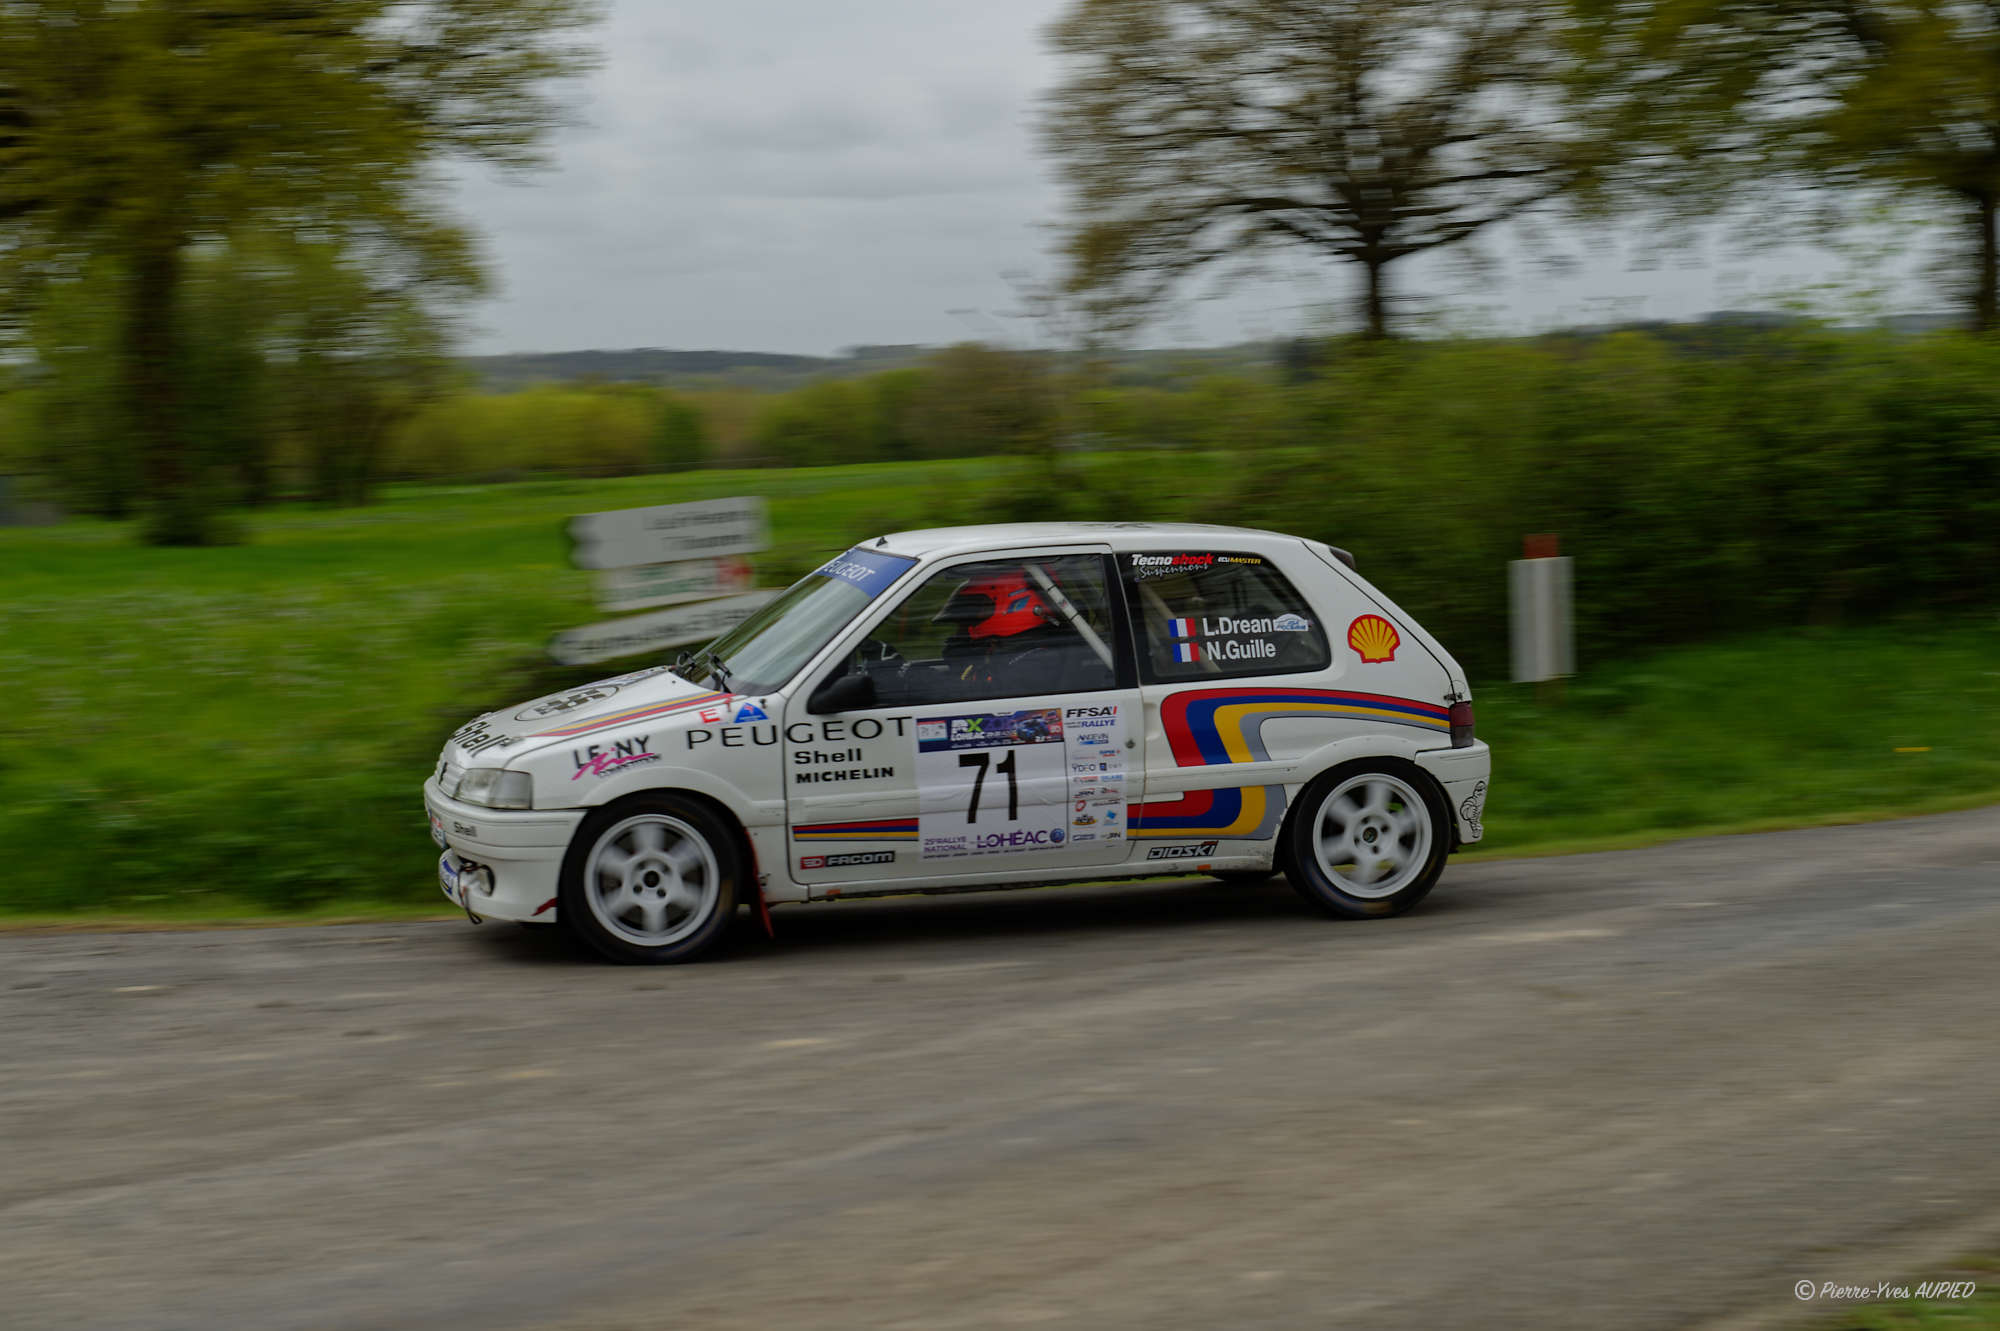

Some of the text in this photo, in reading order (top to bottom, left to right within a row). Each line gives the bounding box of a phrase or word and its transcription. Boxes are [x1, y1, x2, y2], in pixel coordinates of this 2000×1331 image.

[1202, 617, 1272, 636] L.Drean
[1206, 639, 1276, 660] N.Guille
[1067, 706, 1112, 718] FFSA
[1081, 719, 1115, 728] RALLYE
[686, 716, 912, 750] PEUGEOT
[795, 748, 862, 764] Shell
[796, 767, 894, 784] MICHELIN
[959, 750, 1018, 824] 71
[454, 821, 478, 837] Shell
[977, 829, 1048, 848] LOHÉAC
